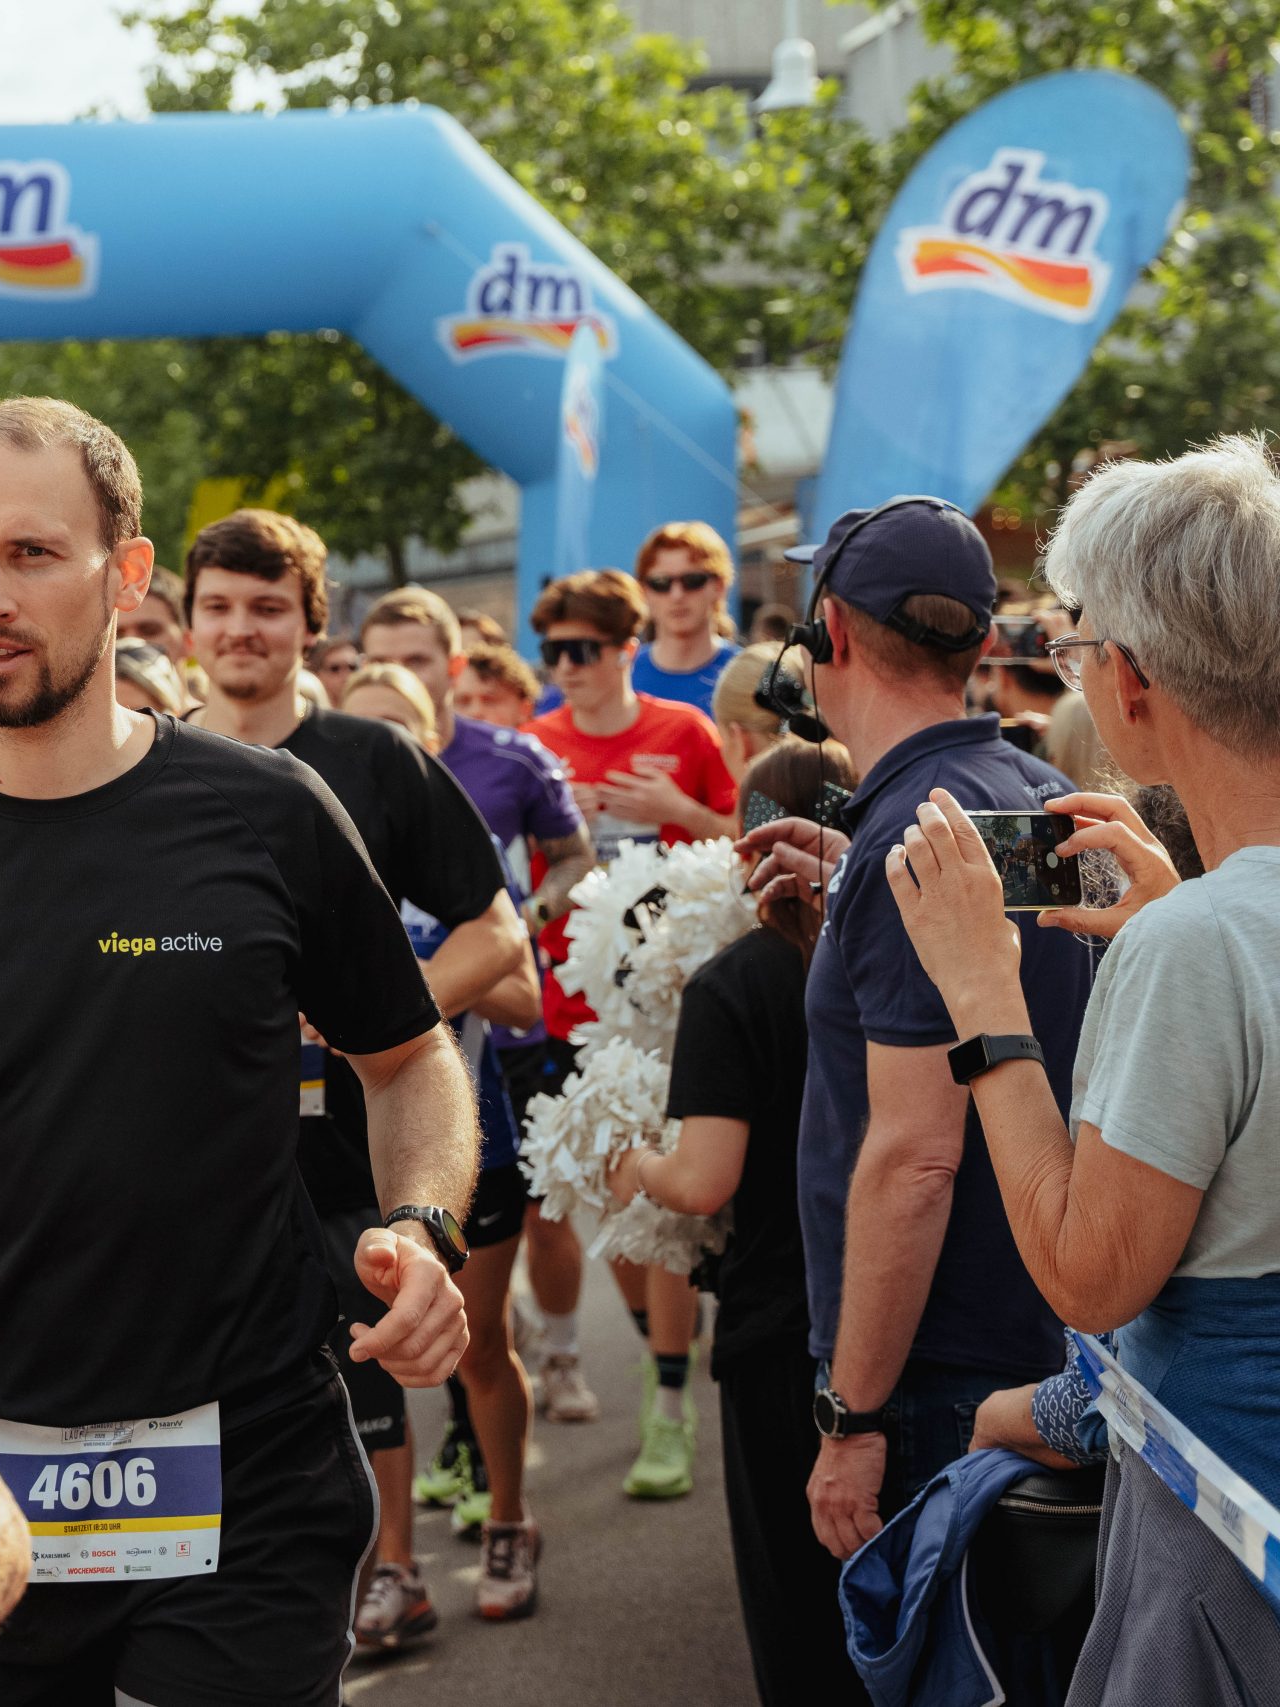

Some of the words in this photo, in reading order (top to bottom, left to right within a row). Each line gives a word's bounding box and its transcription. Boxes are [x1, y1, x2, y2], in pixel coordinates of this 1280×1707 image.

[956, 165, 1093, 254] dm
[480, 254, 583, 315] dm
[98, 932, 156, 957] viega
[161, 932, 222, 951] active
[28, 1457, 157, 1510] 4606
[63, 1523, 93, 1533] STARTZEIT
[109, 1522, 121, 1530] UHR
[91, 1550, 116, 1558] BOSCH
[67, 1566, 116, 1575] WOCHENSPIEGEL
